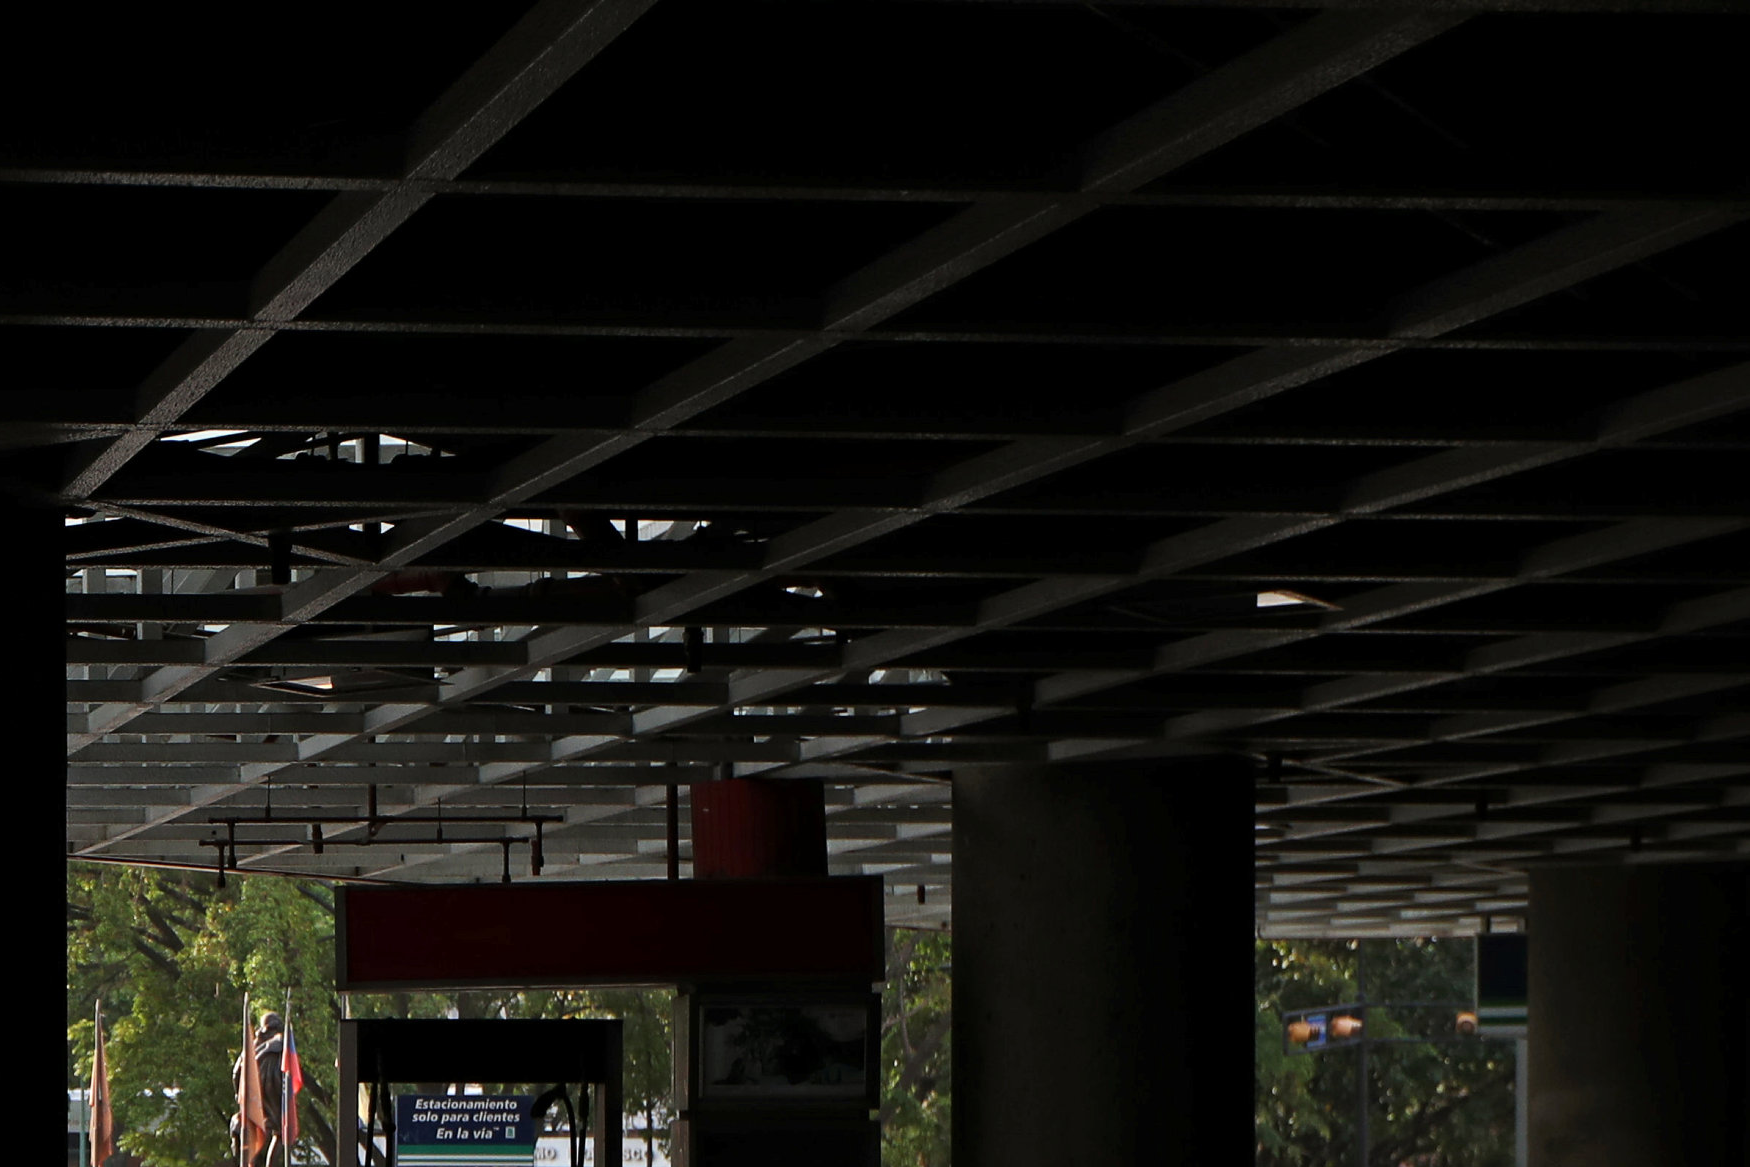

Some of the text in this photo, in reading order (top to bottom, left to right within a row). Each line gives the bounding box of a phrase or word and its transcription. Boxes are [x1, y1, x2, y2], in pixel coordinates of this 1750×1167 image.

[415, 1099, 518, 1110] Estacionamiento
[412, 1111, 521, 1124] solo para clientes
[436, 1127, 453, 1139] En
[457, 1127, 469, 1139] la
